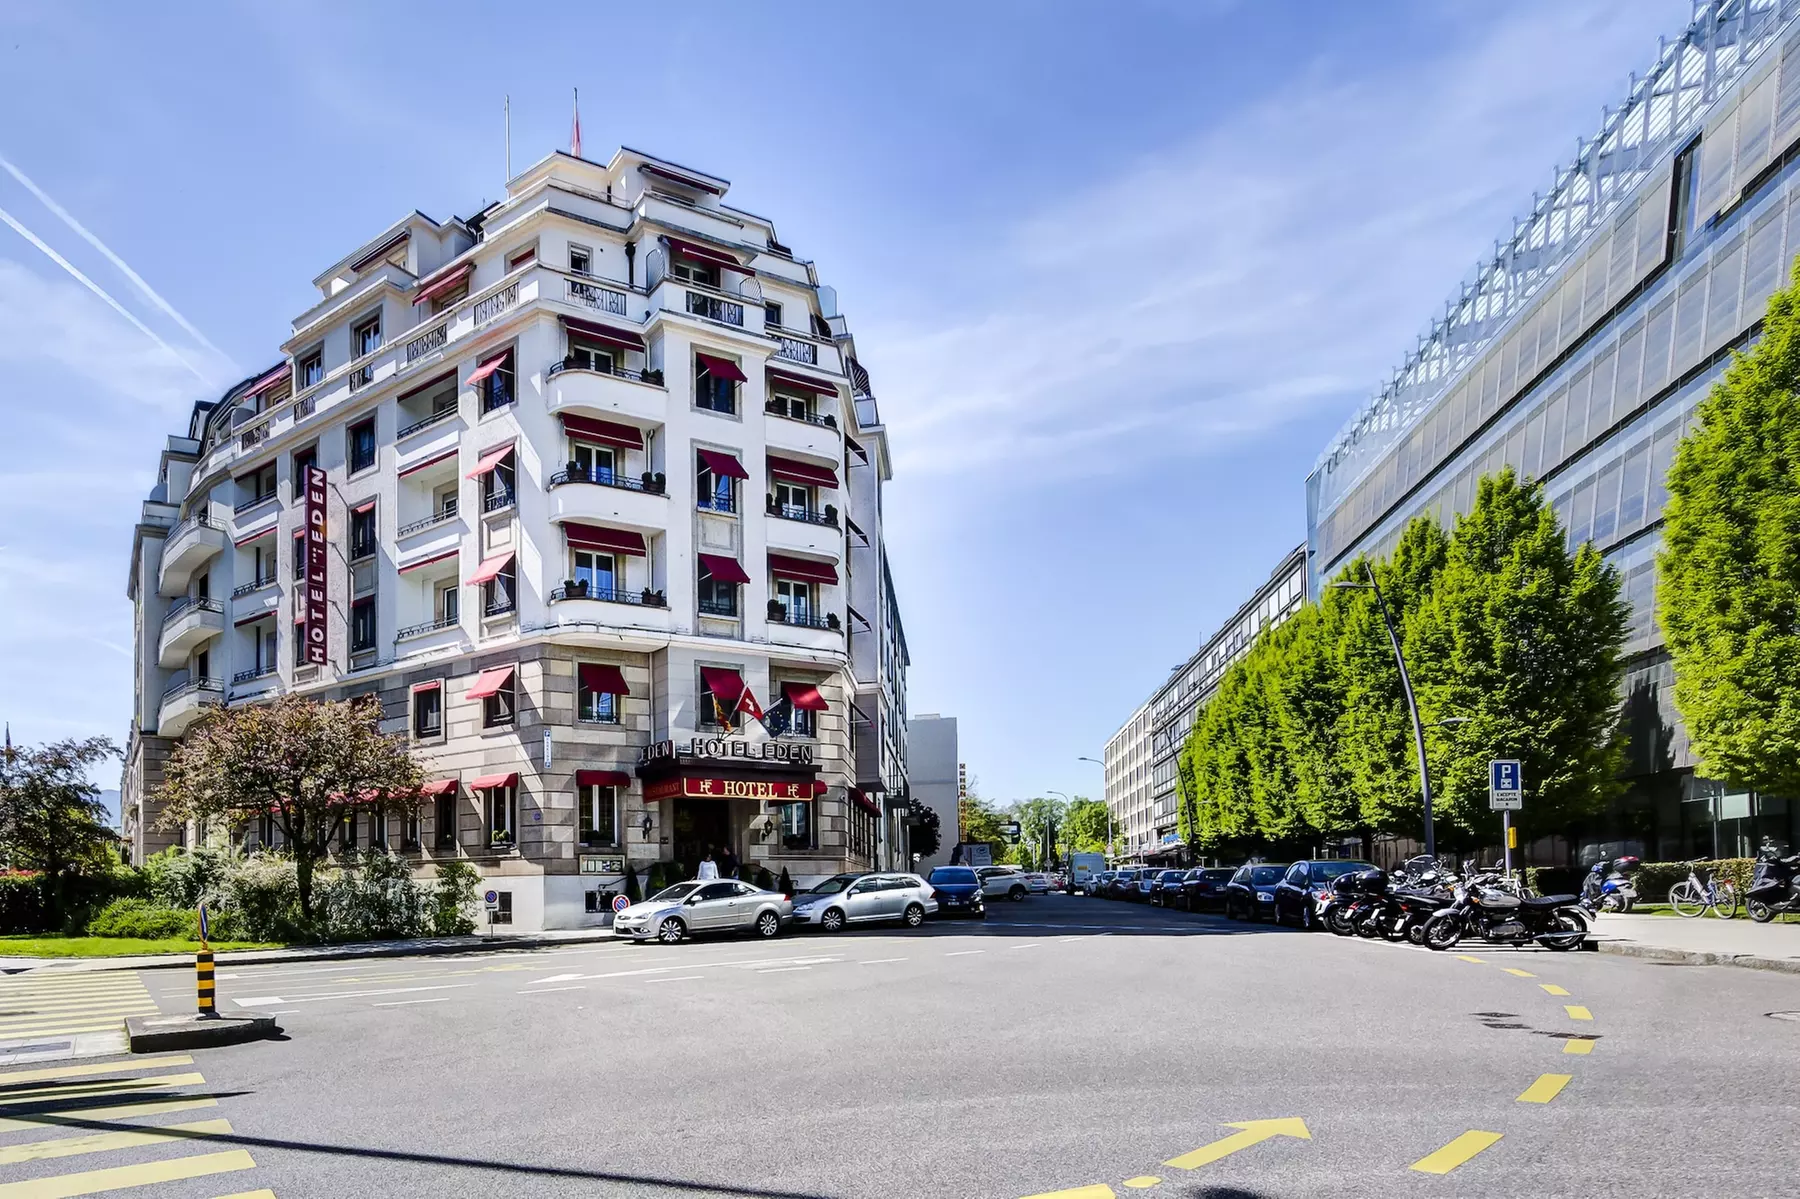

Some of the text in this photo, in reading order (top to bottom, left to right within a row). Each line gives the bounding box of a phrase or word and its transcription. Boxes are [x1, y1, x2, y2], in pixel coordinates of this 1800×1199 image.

[311, 469, 324, 662] HOTEL EDEN
[640, 740, 671, 760] EDEN
[691, 738, 813, 761] HOTEL EDEN
[1502, 764, 1511, 778] P
[722, 780, 778, 798] HOTEL
